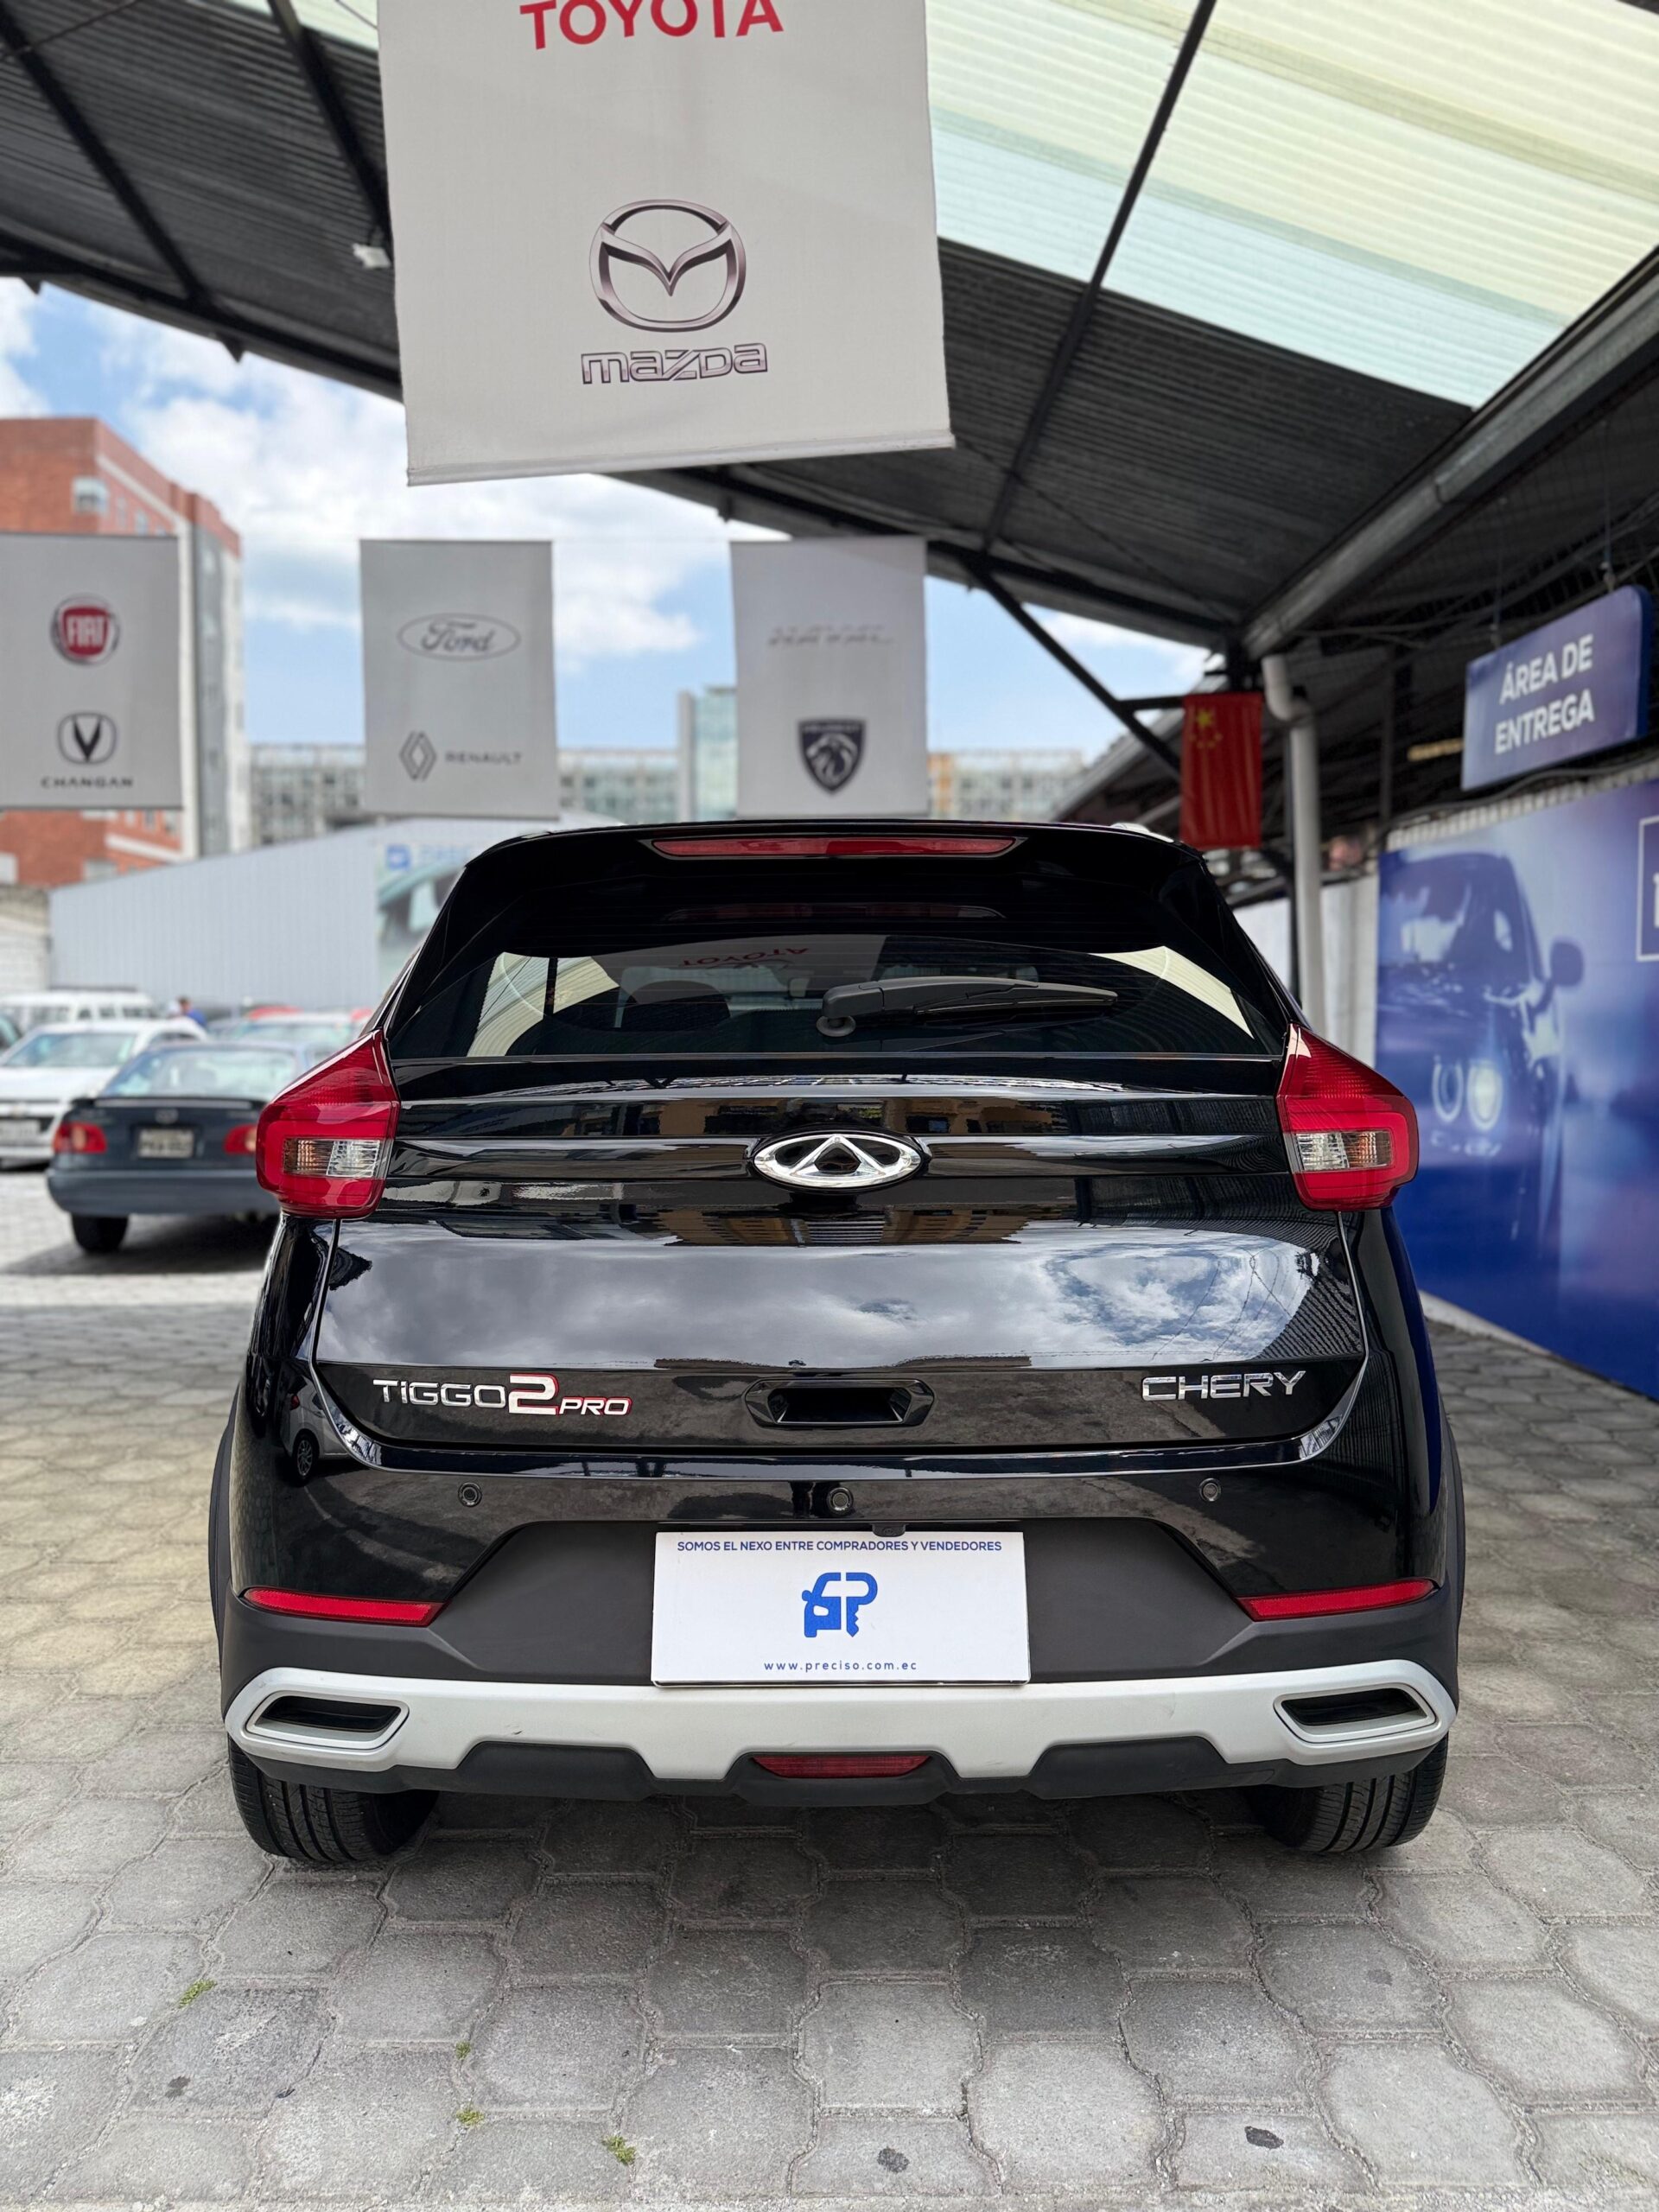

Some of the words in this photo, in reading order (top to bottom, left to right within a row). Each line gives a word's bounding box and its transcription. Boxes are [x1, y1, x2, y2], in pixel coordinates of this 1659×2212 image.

[519, 0, 785, 49] TOYOTA
[421, 620, 495, 652] Ford
[1499, 661, 1558, 705] ÁREA
[1561, 633, 1593, 679] DE
[1495, 688, 1594, 754] ENTREGA
[1142, 1370, 1306, 1402] CHERY
[677, 1541, 721, 1551] SOMOS
[723, 1541, 737, 1551] EL
[740, 1541, 772, 1551] NEXO
[775, 1541, 814, 1551] ENTRE
[817, 1541, 908, 1551] COMPRADORES
[911, 1541, 919, 1551] Y
[920, 1541, 1002, 1551] VENDEDORES
[764, 1660, 917, 1673] www.preciso.com.ec
